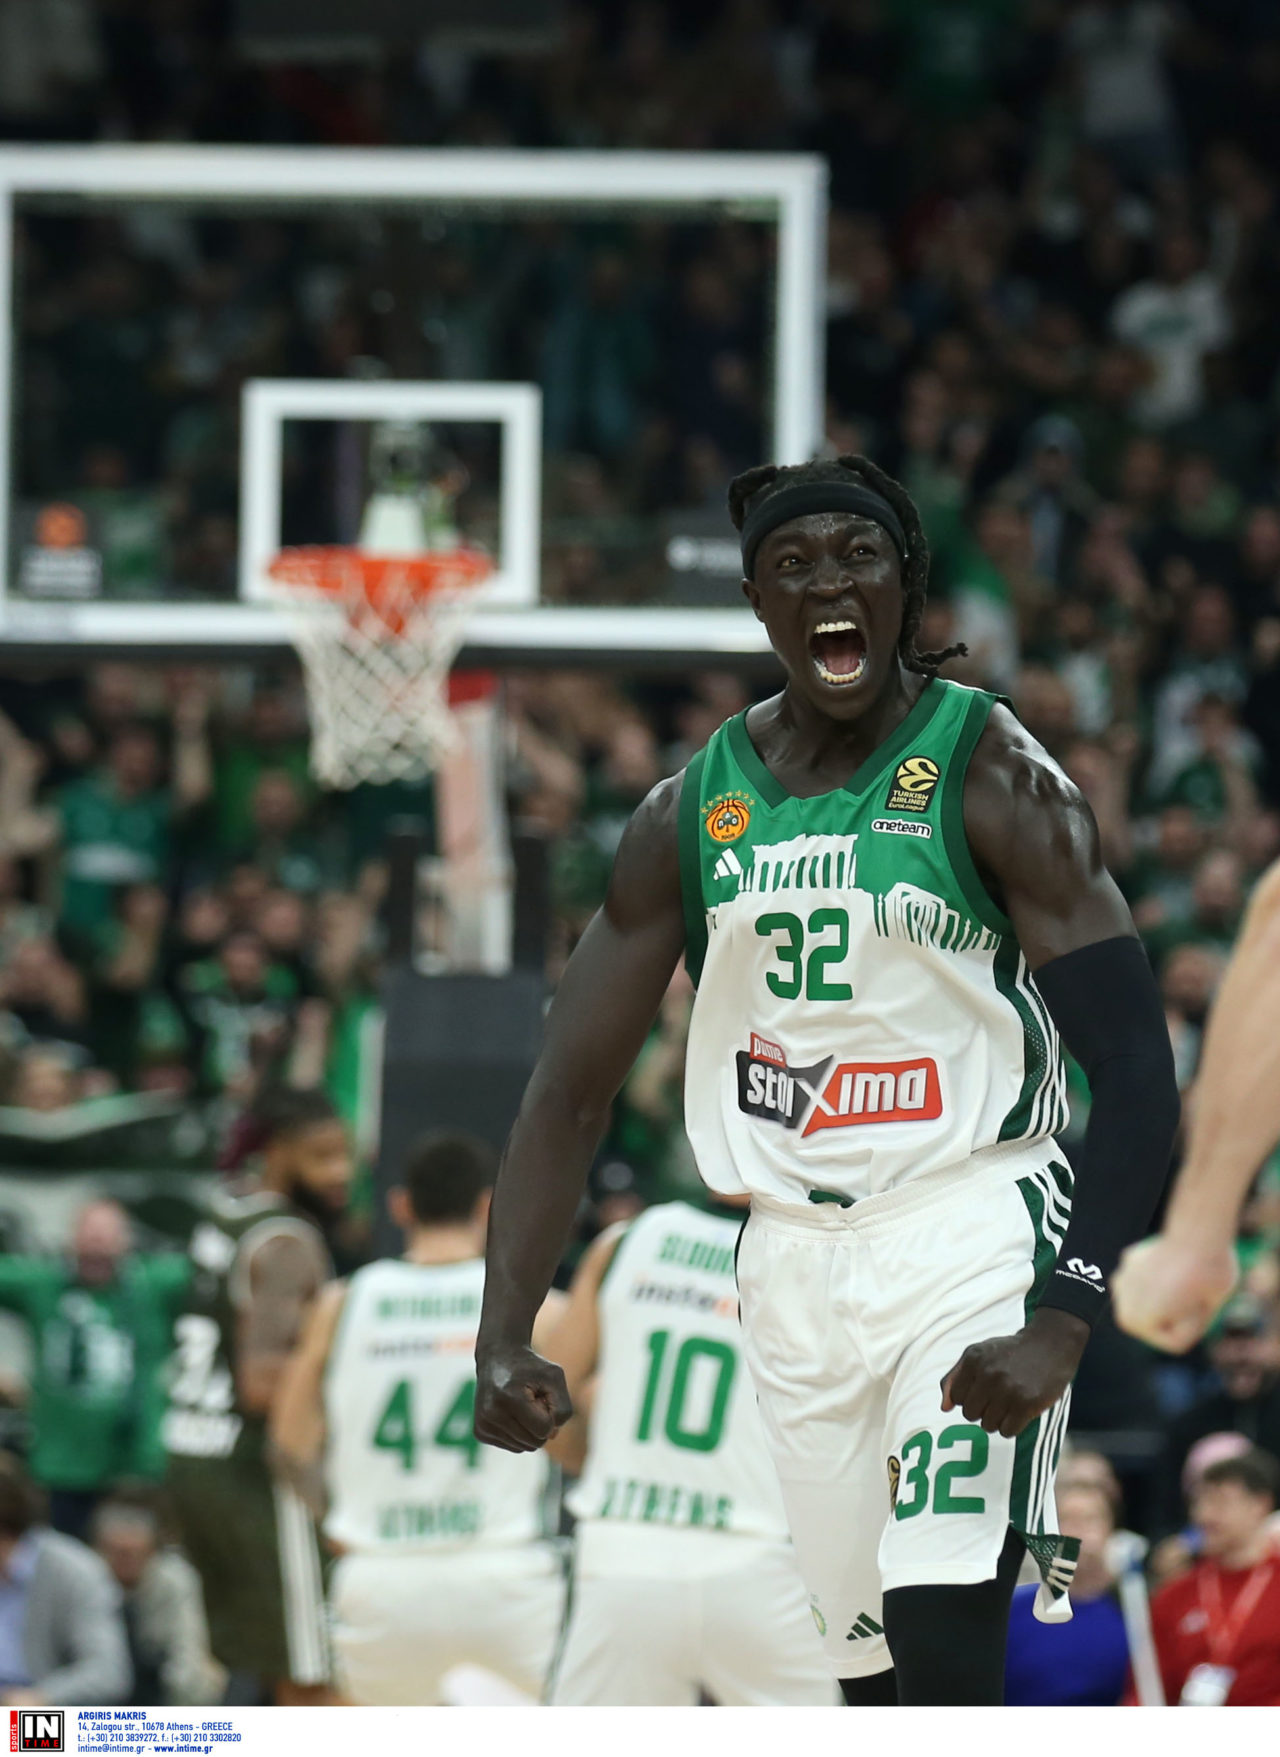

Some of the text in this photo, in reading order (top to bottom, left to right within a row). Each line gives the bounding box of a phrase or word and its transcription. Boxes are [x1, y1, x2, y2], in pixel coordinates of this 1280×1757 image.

[873, 820, 931, 837] oneteam
[890, 796, 927, 807] AIRLINES
[892, 790, 929, 801] TURKISH
[755, 908, 854, 1001] 32
[373, 1379, 479, 1472] 44
[638, 1330, 737, 1453] 10
[895, 1424, 990, 1521] 32
